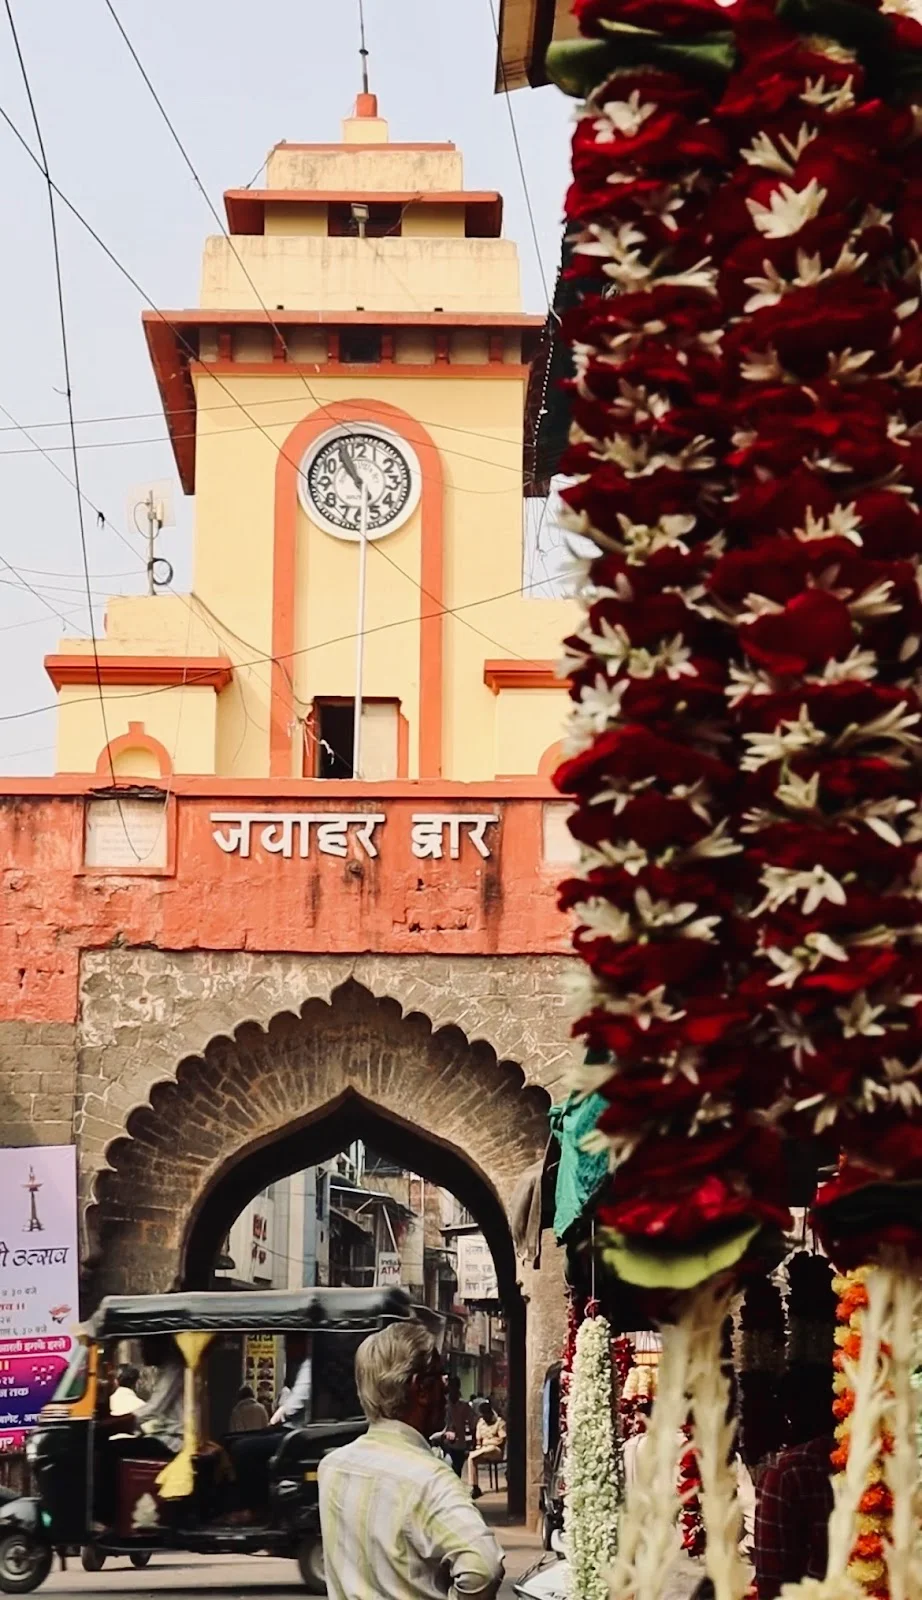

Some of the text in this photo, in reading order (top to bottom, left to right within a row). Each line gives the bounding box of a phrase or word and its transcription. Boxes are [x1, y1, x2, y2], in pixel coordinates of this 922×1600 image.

[350, 443, 367, 459] 12
[321, 458, 337, 474] 10
[383, 458, 394, 473] 2
[317, 475, 332, 490] 9
[385, 475, 401, 491] 3
[325, 492, 337, 508] 8
[382, 493, 396, 508] 4
[339, 505, 350, 519] 7
[369, 505, 381, 519] 5
[210, 812, 499, 859] जवाहर द्वार
[380, 1266, 400, 1275] ATM
